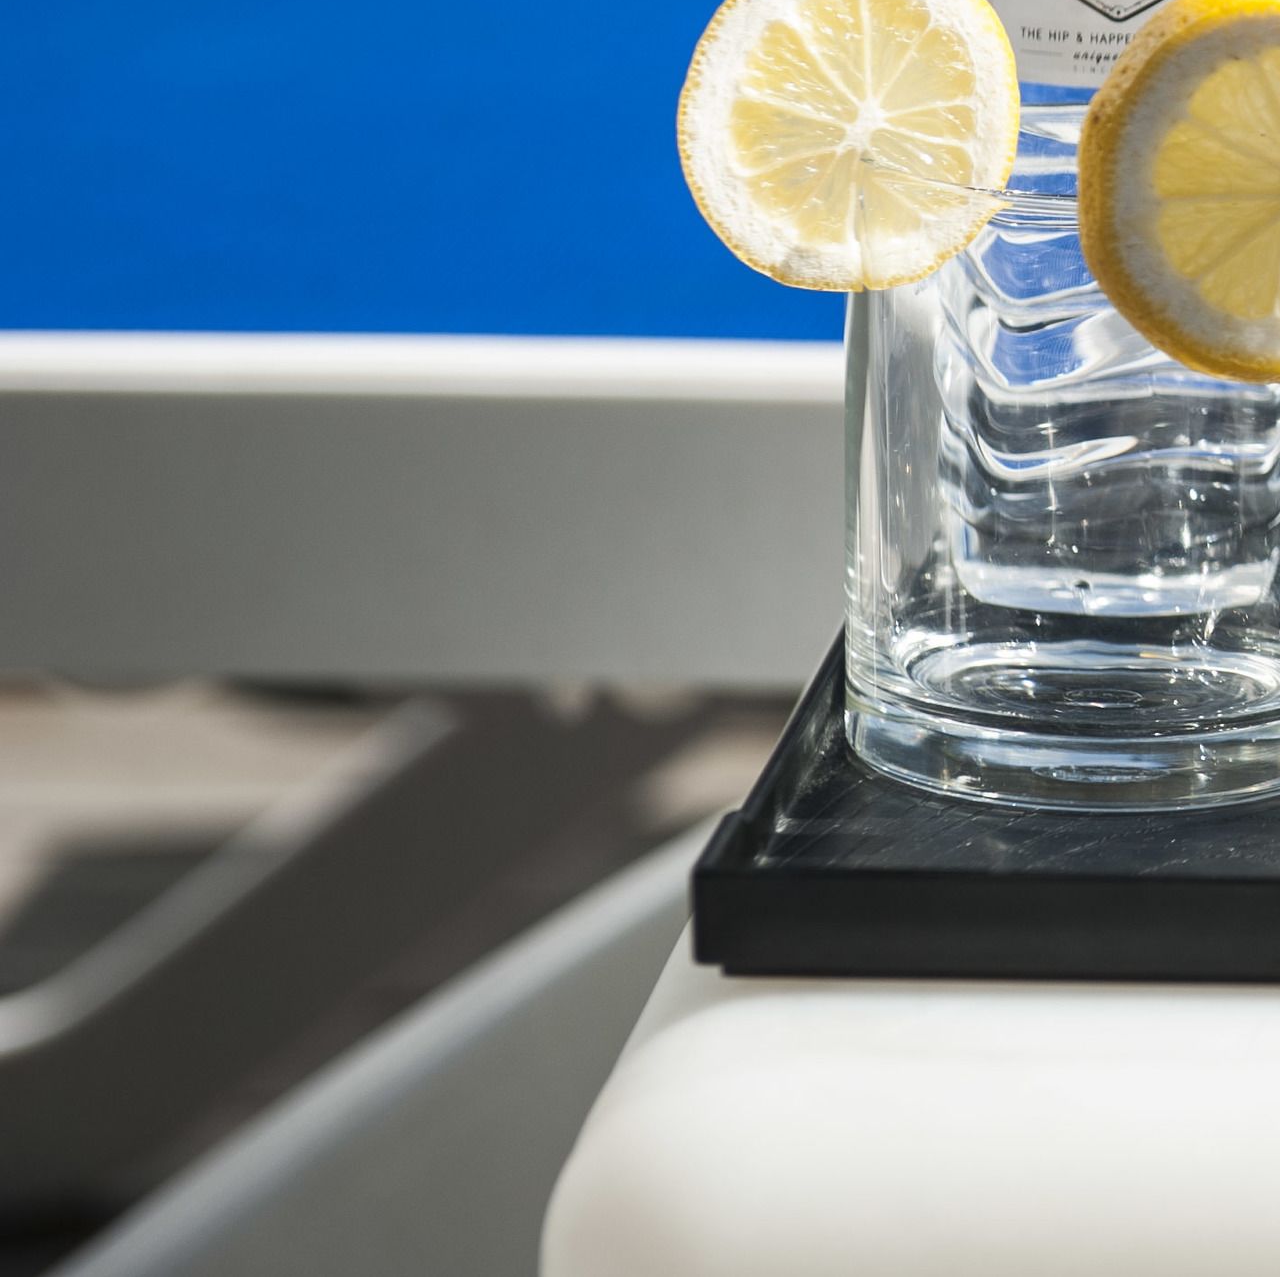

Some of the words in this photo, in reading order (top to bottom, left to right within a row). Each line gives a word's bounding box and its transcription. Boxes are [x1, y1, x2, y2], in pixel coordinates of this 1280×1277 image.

[1021, 26, 1042, 40] THE
[1049, 29, 1069, 43] HIP
[1076, 32, 1083, 43] &
[1090, 33, 1136, 45] HAPPE
